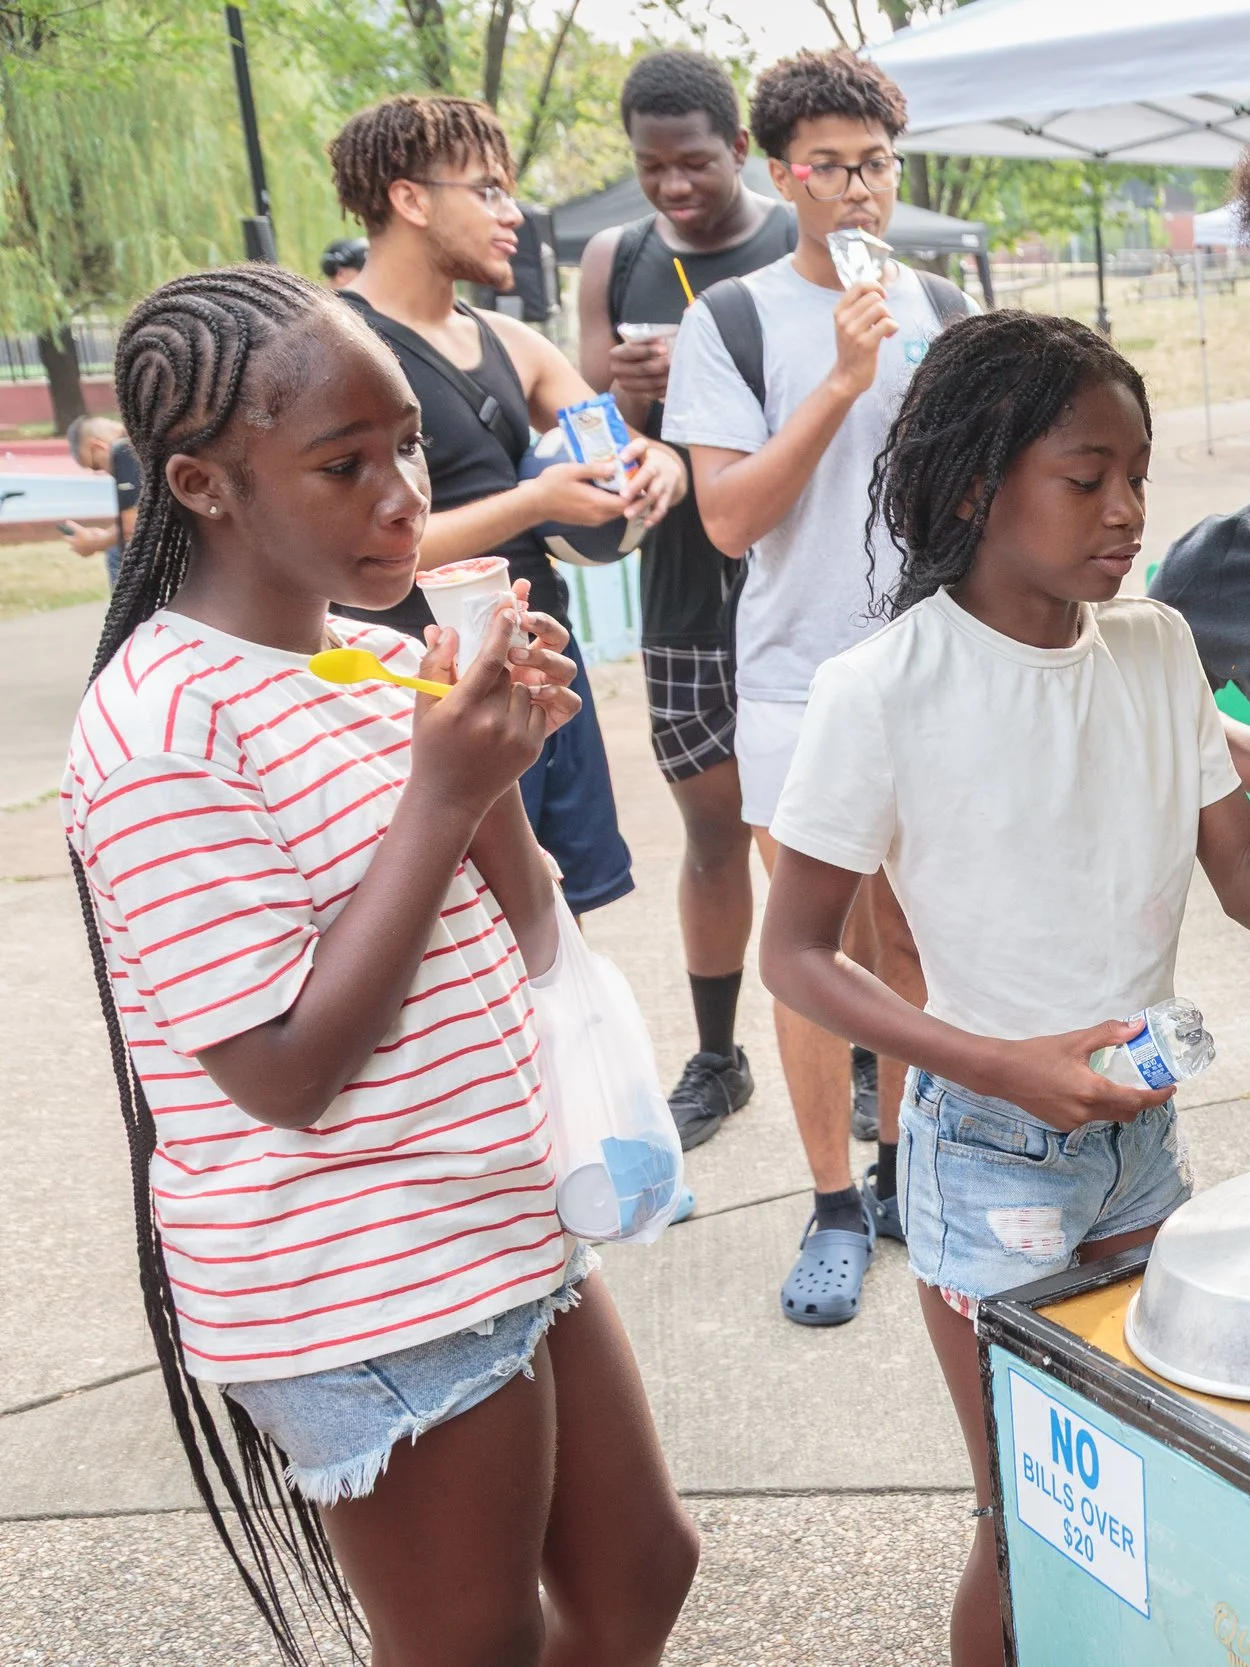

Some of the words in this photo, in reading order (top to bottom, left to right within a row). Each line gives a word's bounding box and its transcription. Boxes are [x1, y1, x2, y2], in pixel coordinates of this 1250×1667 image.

[1050, 1407, 1099, 1490] NO
[1023, 1452, 1074, 1512] BILLS
[1081, 1497, 1135, 1559] OVER
[1063, 1517, 1094, 1562] $20
